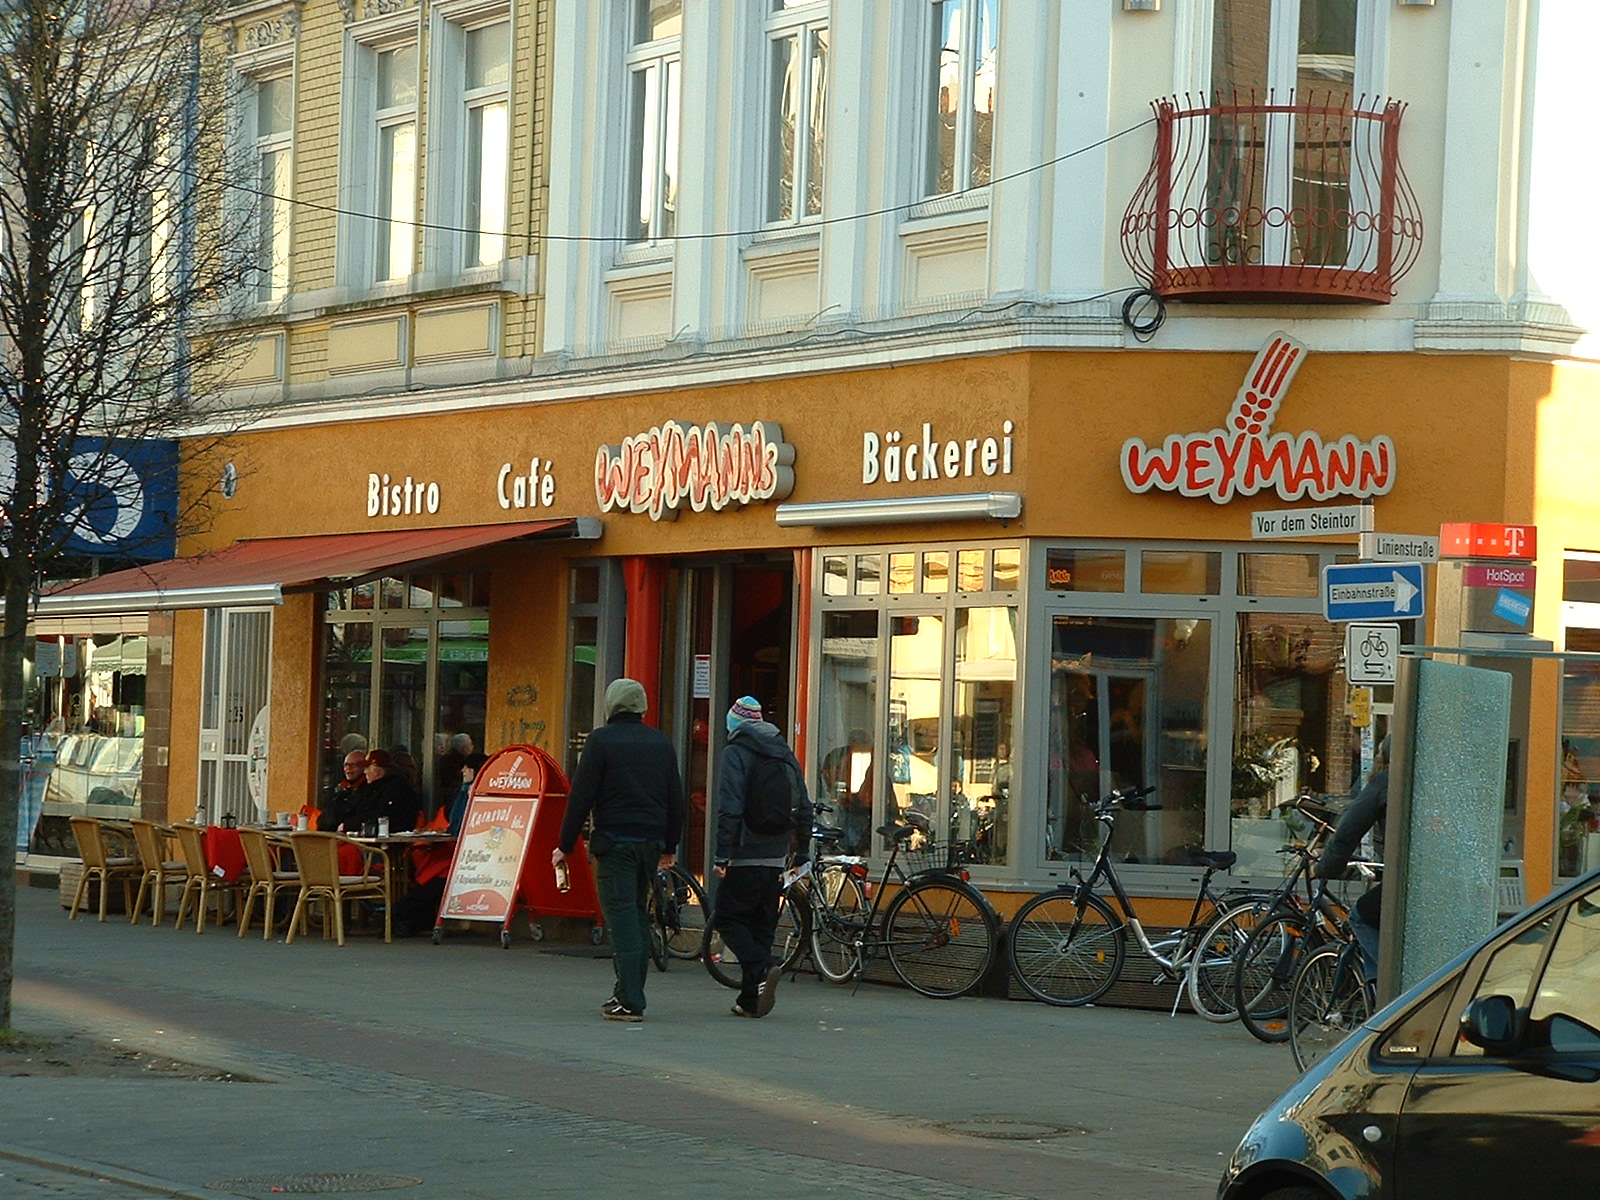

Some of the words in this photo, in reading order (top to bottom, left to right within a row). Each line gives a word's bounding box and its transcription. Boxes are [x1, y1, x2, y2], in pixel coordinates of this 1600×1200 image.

[862, 420, 1013, 485] Bäckerei
[1122, 428, 1395, 504] WEYMANN
[366, 472, 440, 517] Bistro
[497, 457, 555, 509] Café
[1257, 515, 1276, 533] Vor
[1281, 514, 1305, 532] dem
[1311, 512, 1357, 530] Steintor
[1376, 537, 1435, 558] Linienstraße
[1504, 527, 1525, 556] T
[1486, 568, 1525, 583] HotSpot
[1331, 585, 1396, 601] Einbahnstraße
